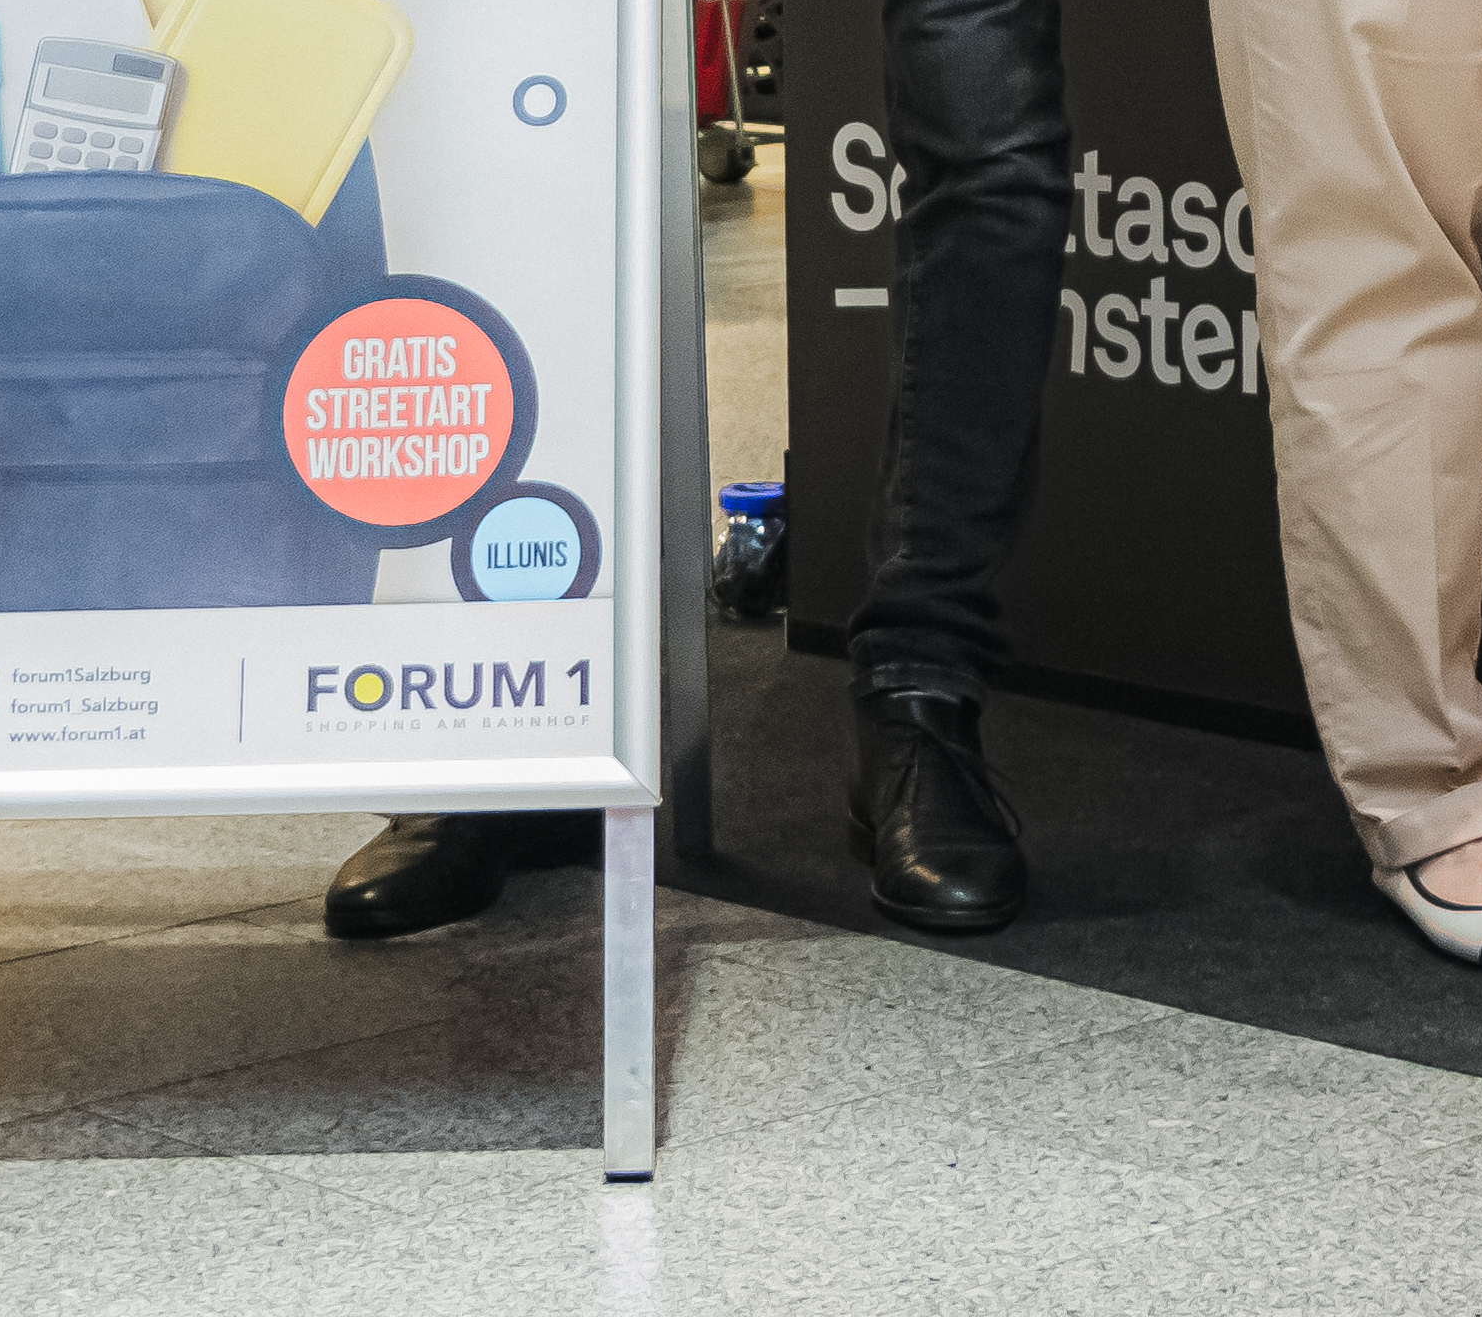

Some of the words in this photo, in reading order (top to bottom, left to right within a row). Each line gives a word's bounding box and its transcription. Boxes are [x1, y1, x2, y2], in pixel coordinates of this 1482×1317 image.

[342, 335, 457, 381] GRATIS
[306, 383, 492, 430] STREETART
[307, 433, 490, 480] WORKSHOP
[486, 540, 568, 570] ILLUNIS
[12, 666, 152, 685] forum1Salzburg
[306, 659, 546, 713] FORUM
[566, 658, 591, 706] 1
[10, 697, 159, 715] forum1_Salzburg
[9, 726, 146, 742] www.forum1.at
[305, 718, 421, 733] SHOPPING
[437, 716, 467, 729] AM
[482, 714, 591, 729] BAHNHOF
